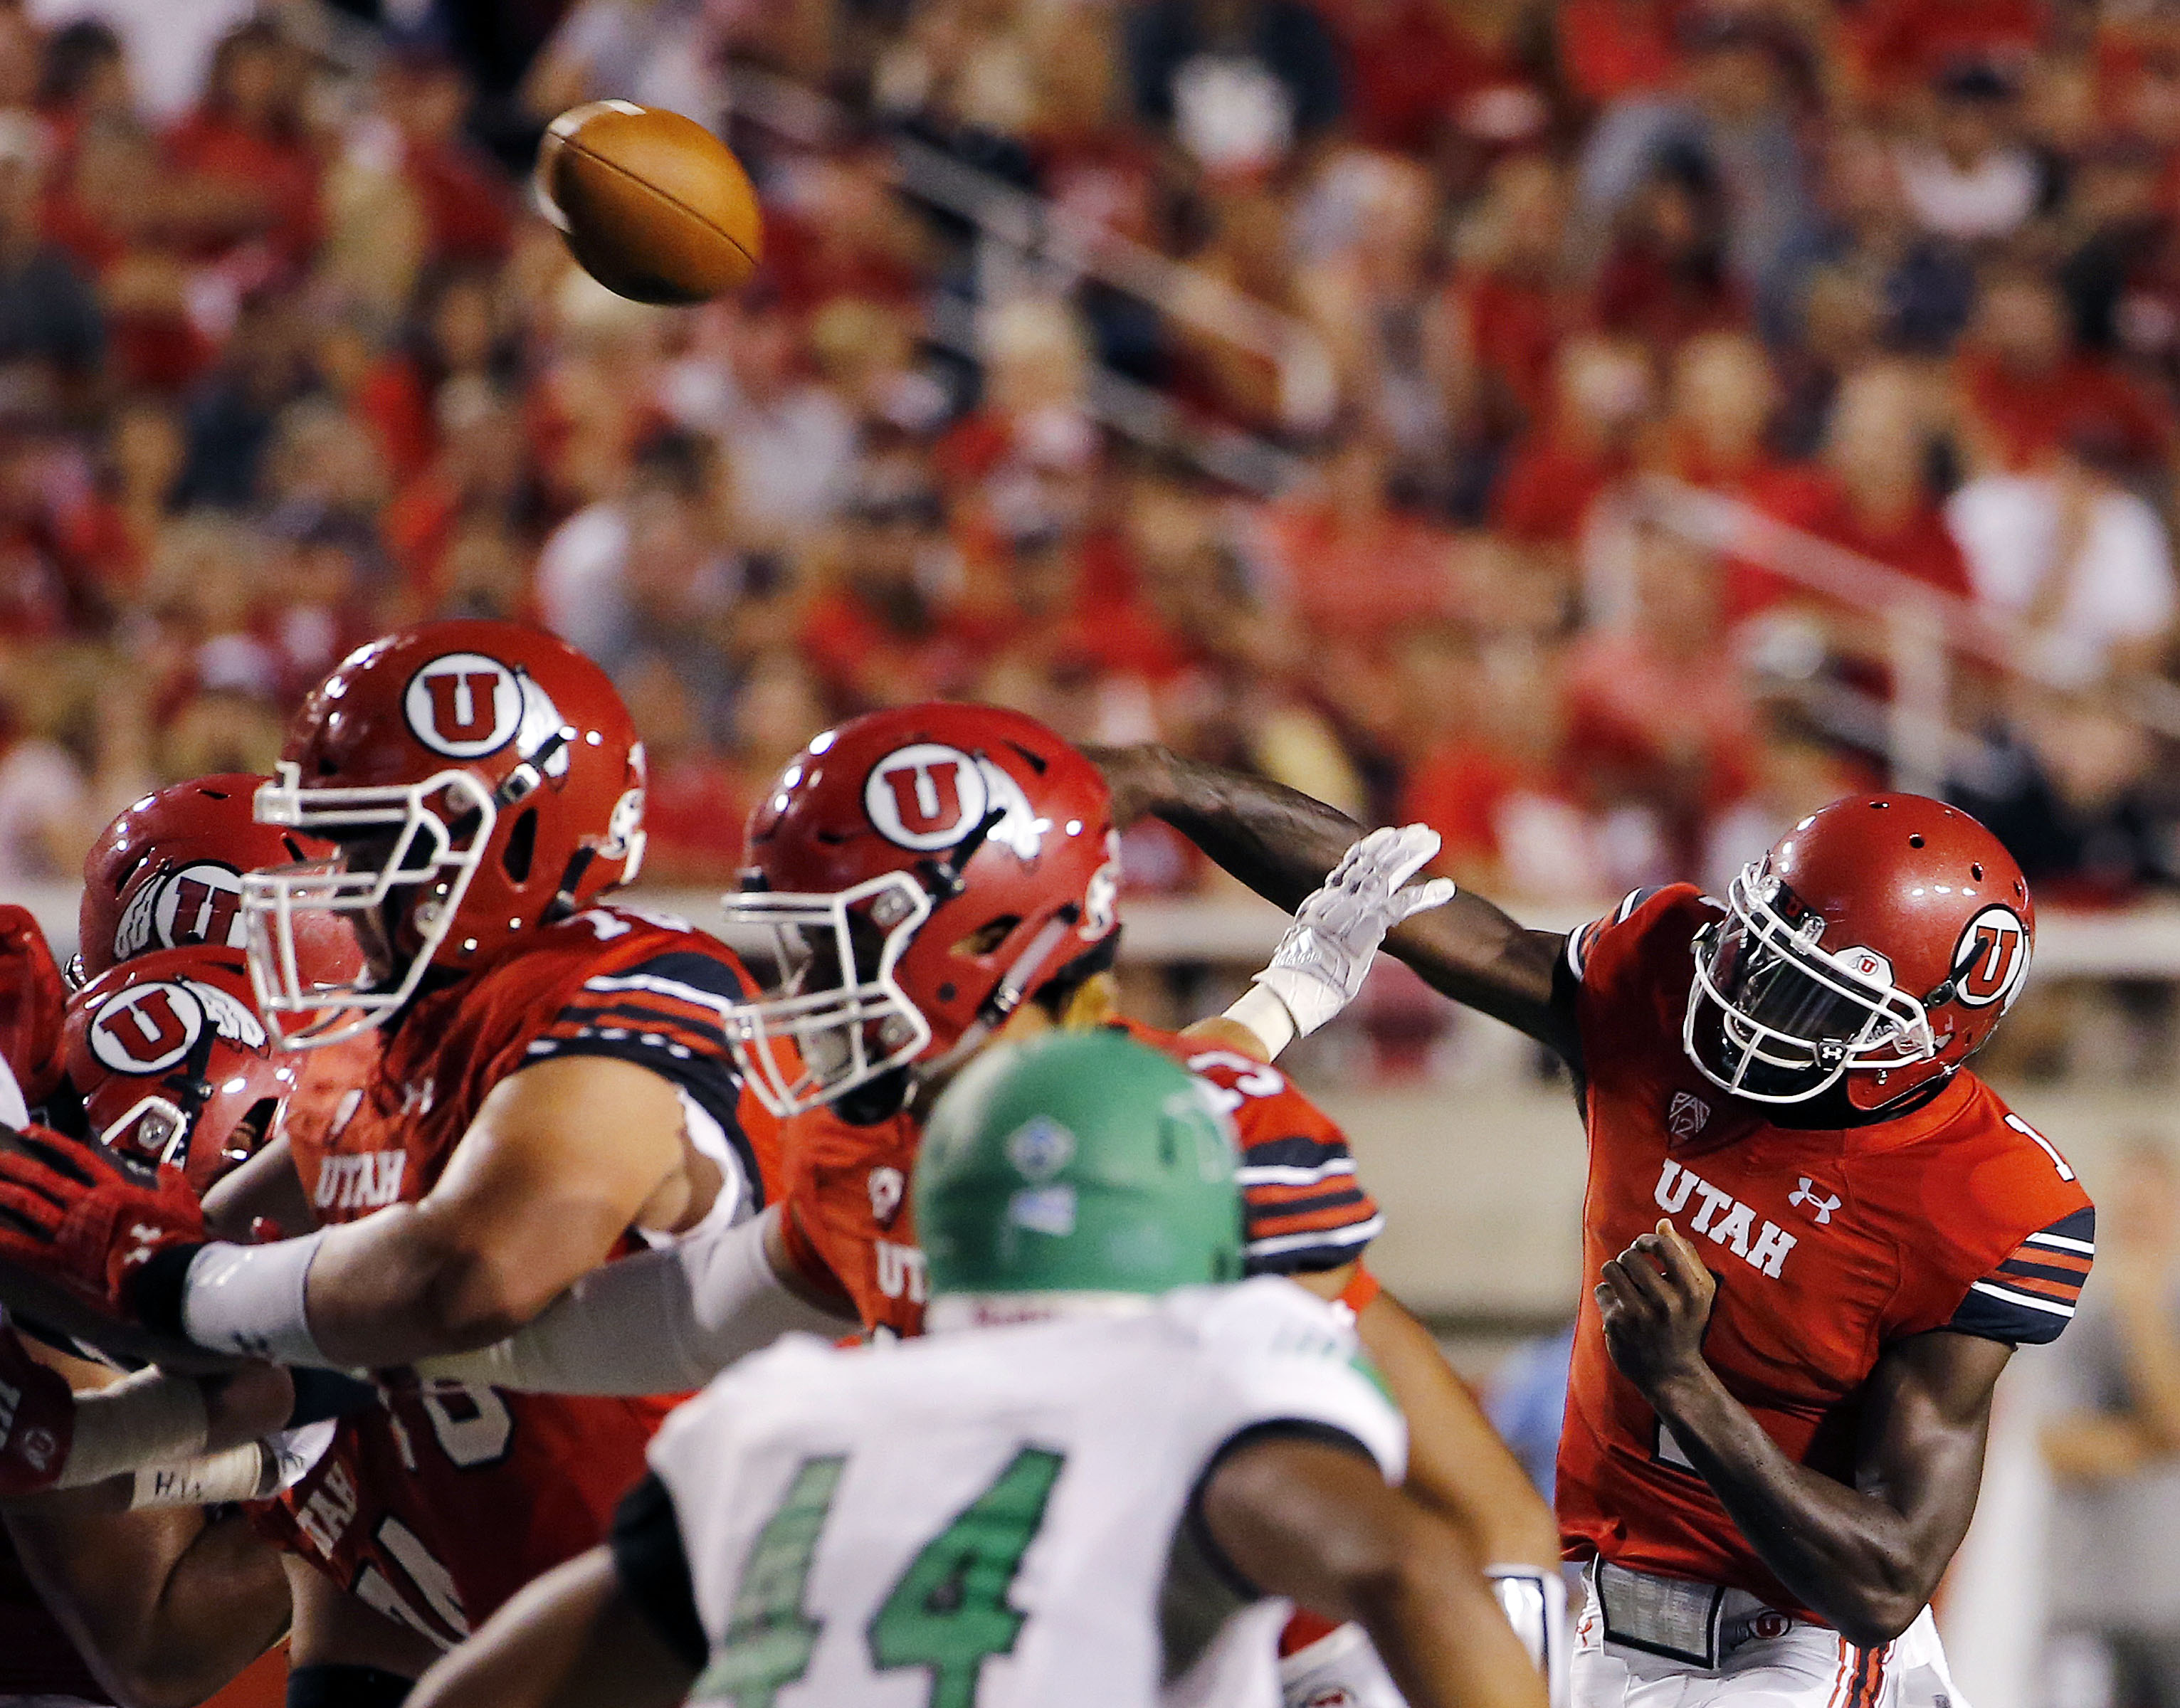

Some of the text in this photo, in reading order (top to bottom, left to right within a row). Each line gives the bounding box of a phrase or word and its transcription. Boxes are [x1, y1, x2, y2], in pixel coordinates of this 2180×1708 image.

[423, 672, 500, 742] U
[883, 761, 966, 836] U
[1860, 958, 1876, 974] U
[1965, 924, 2019, 998] U
[100, 988, 188, 1058] U
[314, 1148, 406, 1208] UTAH
[1653, 1157, 1799, 1280] UTAH
[875, 1240, 927, 1305] UT
[295, 1459, 357, 1561] TAH
